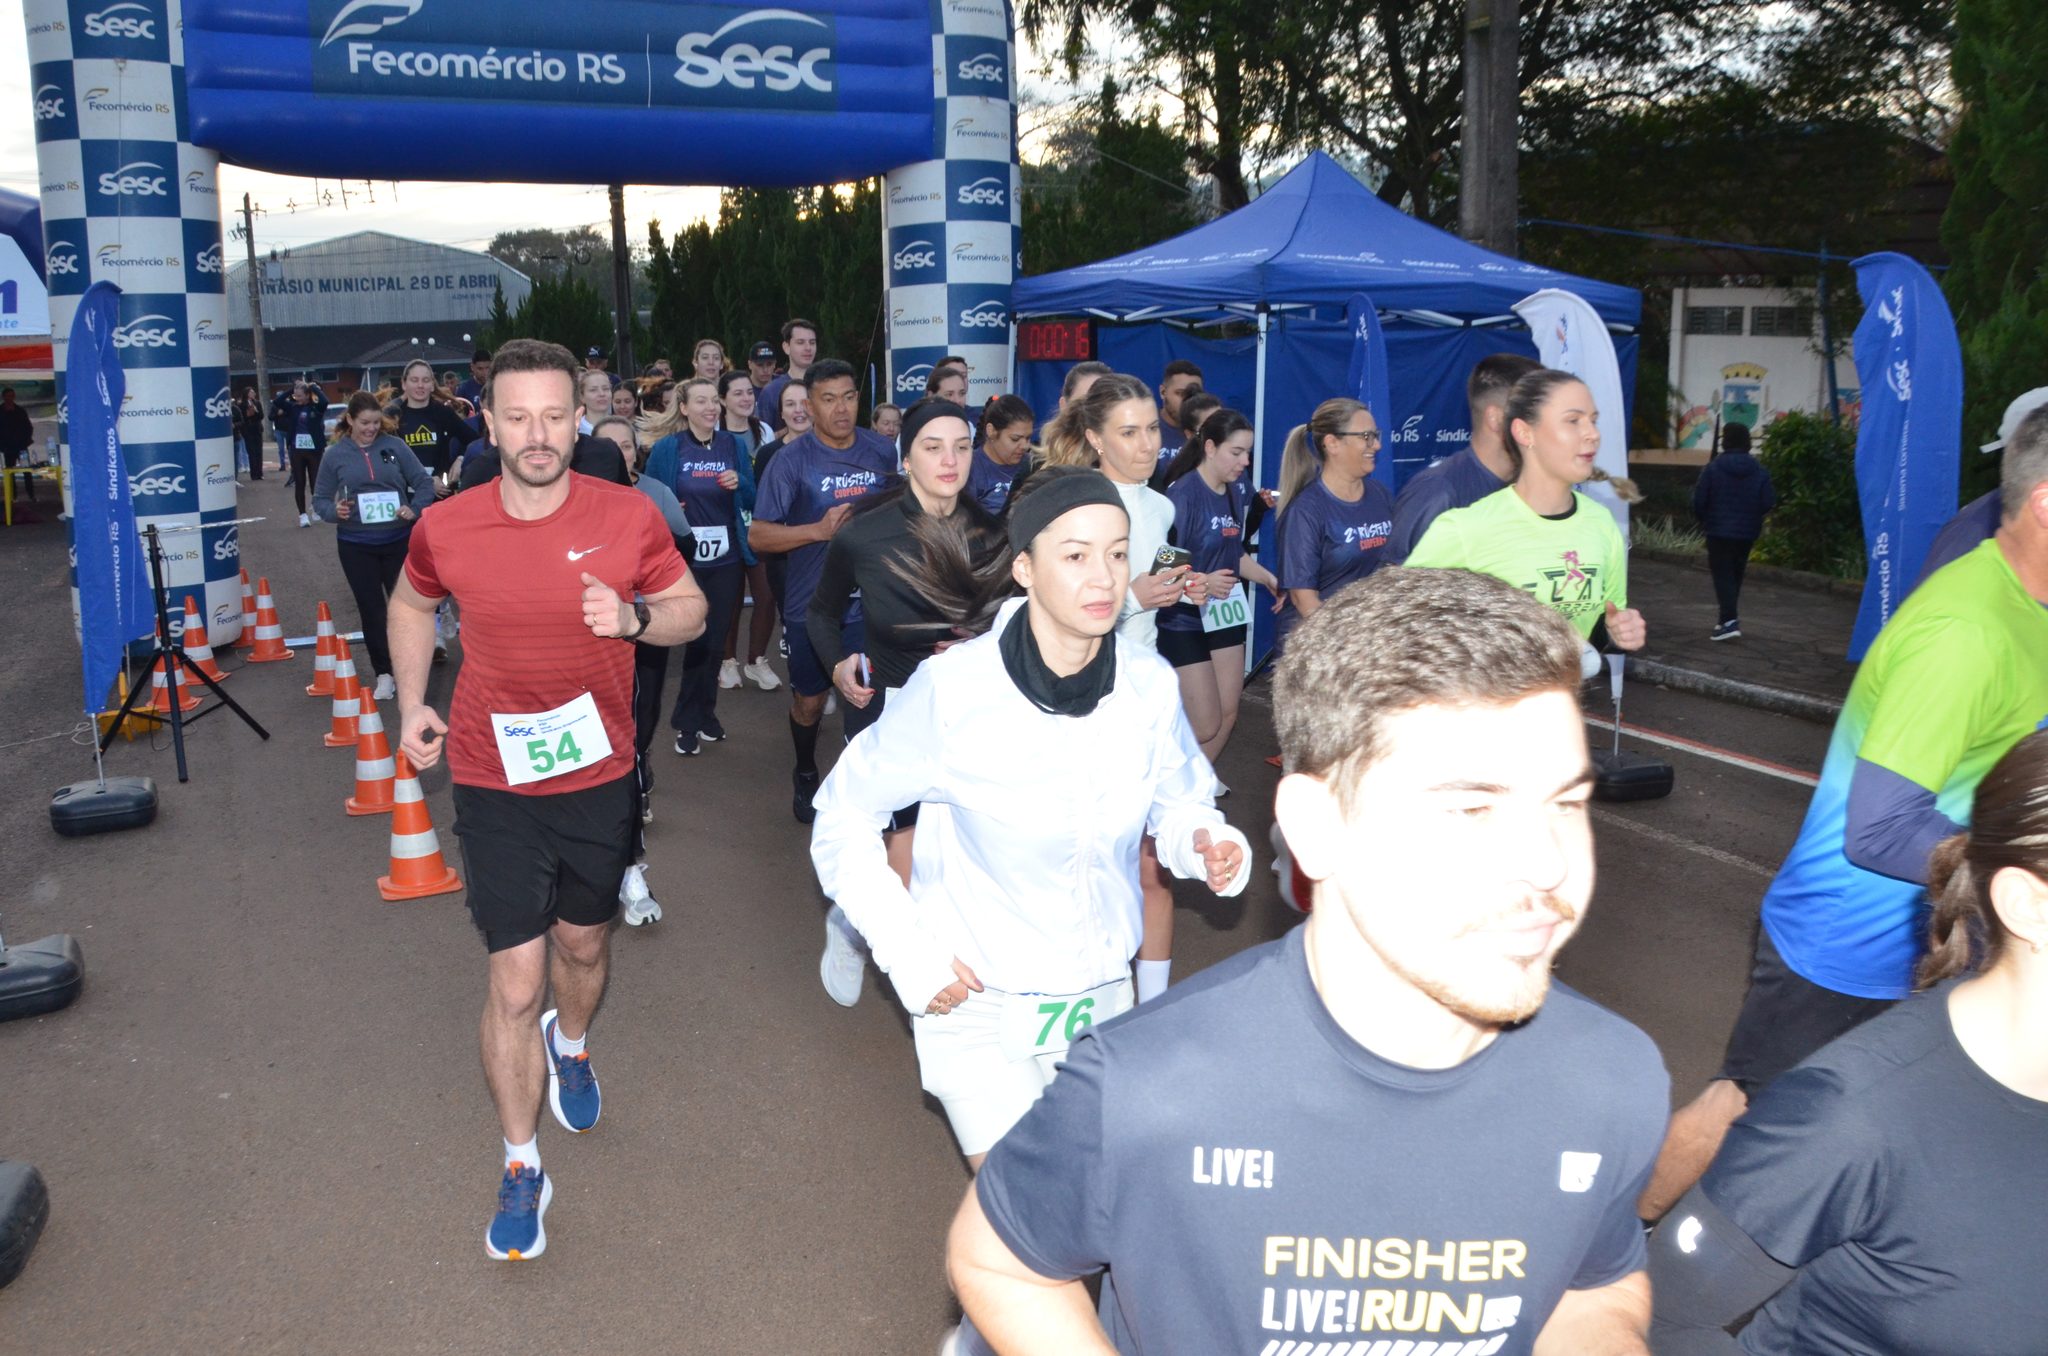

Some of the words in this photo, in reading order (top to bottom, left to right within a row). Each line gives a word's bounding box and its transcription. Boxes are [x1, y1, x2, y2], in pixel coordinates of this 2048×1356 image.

[84, 13, 155, 39] Sesc
[347, 41, 566, 82] Fecomércio
[578, 54, 627, 84] RS
[674, 31, 832, 92] Sesc
[958, 61, 1003, 83] Sesc
[89, 102, 152, 112] Fecomércio
[155, 103, 170, 113] RS
[98, 173, 167, 195] Sesc
[958, 185, 1004, 205] Sesc
[102, 258, 163, 267] Fecomércio
[166, 257, 180, 266] RS
[893, 251, 935, 270] Sesc
[319, 276, 405, 293] MUNICIPAL
[410, 276, 430, 290] 29
[435, 276, 454, 289] DE
[960, 309, 1006, 328] Sesc
[112, 327, 176, 348] Sesc
[896, 374, 928, 392] Ses
[1894, 359, 1912, 401] Sesc
[120, 407, 173, 417] ecomércio
[175, 406, 189, 415] RS
[205, 398, 232, 418] Ses
[1403, 429, 1419, 442] RS
[1435, 428, 1471, 442] Sindic
[106, 428, 118, 500] Sindicatos
[128, 475, 186, 496] Sesc
[366, 502, 396, 520] 219
[110, 521, 119, 540] RS
[214, 540, 240, 560] Ses
[1876, 532, 1888, 555] RS
[186, 550, 198, 560] RS
[1878, 560, 1890, 626] omércio
[1208, 599, 1245, 627] 100
[504, 726, 536, 737] Sesc
[526, 730, 582, 773] 54
[1035, 997, 1095, 1046] 76
[1193, 1146, 1273, 1188] LIVE!
[1264, 1235, 1527, 1282] FINISHER
